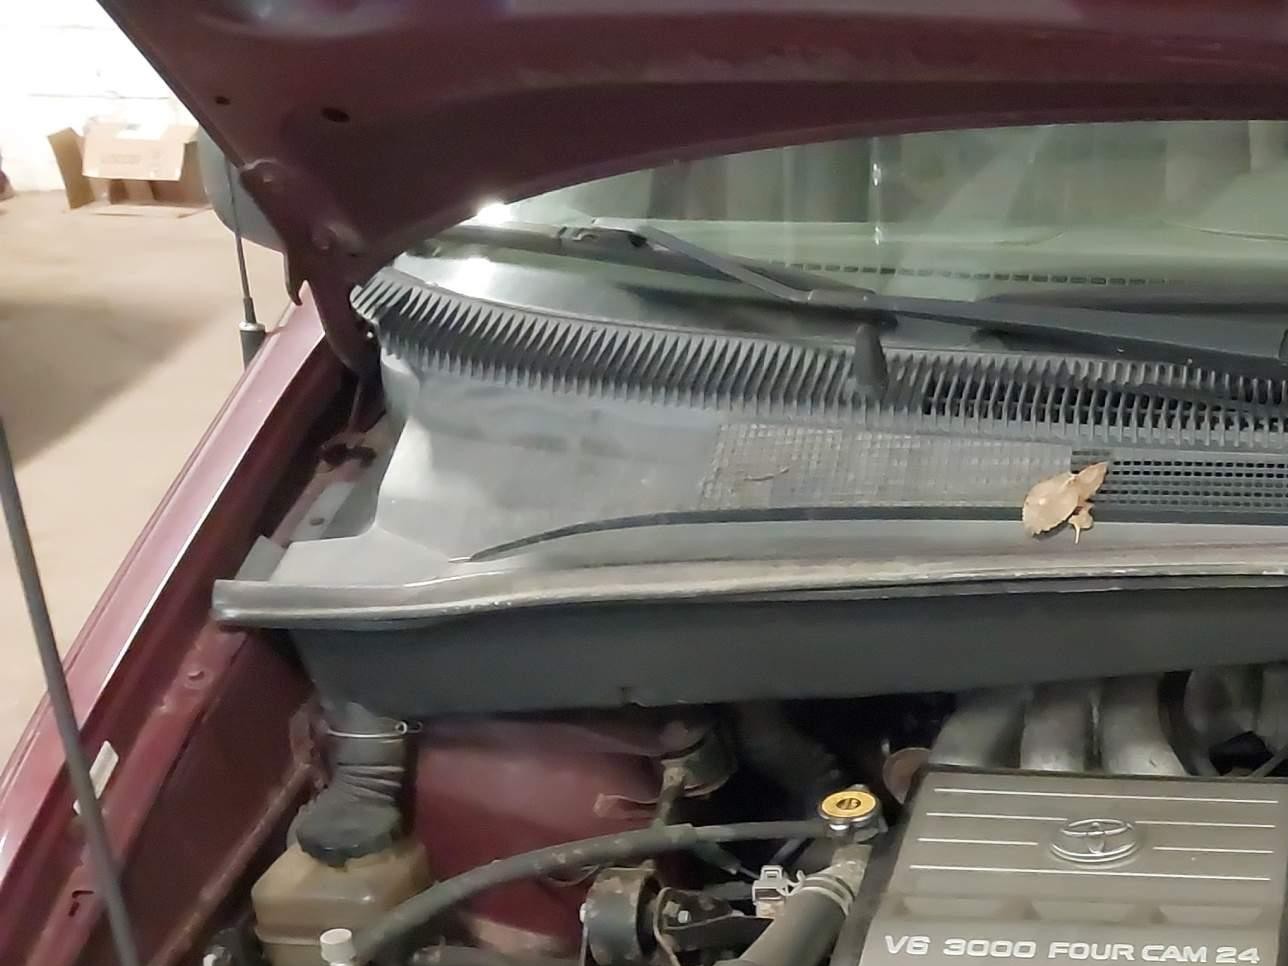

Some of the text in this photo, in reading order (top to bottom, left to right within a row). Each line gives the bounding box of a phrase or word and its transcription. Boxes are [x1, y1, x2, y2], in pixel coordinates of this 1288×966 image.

[884, 935, 1261, 964] V6 3000 FOUR CAM 24
